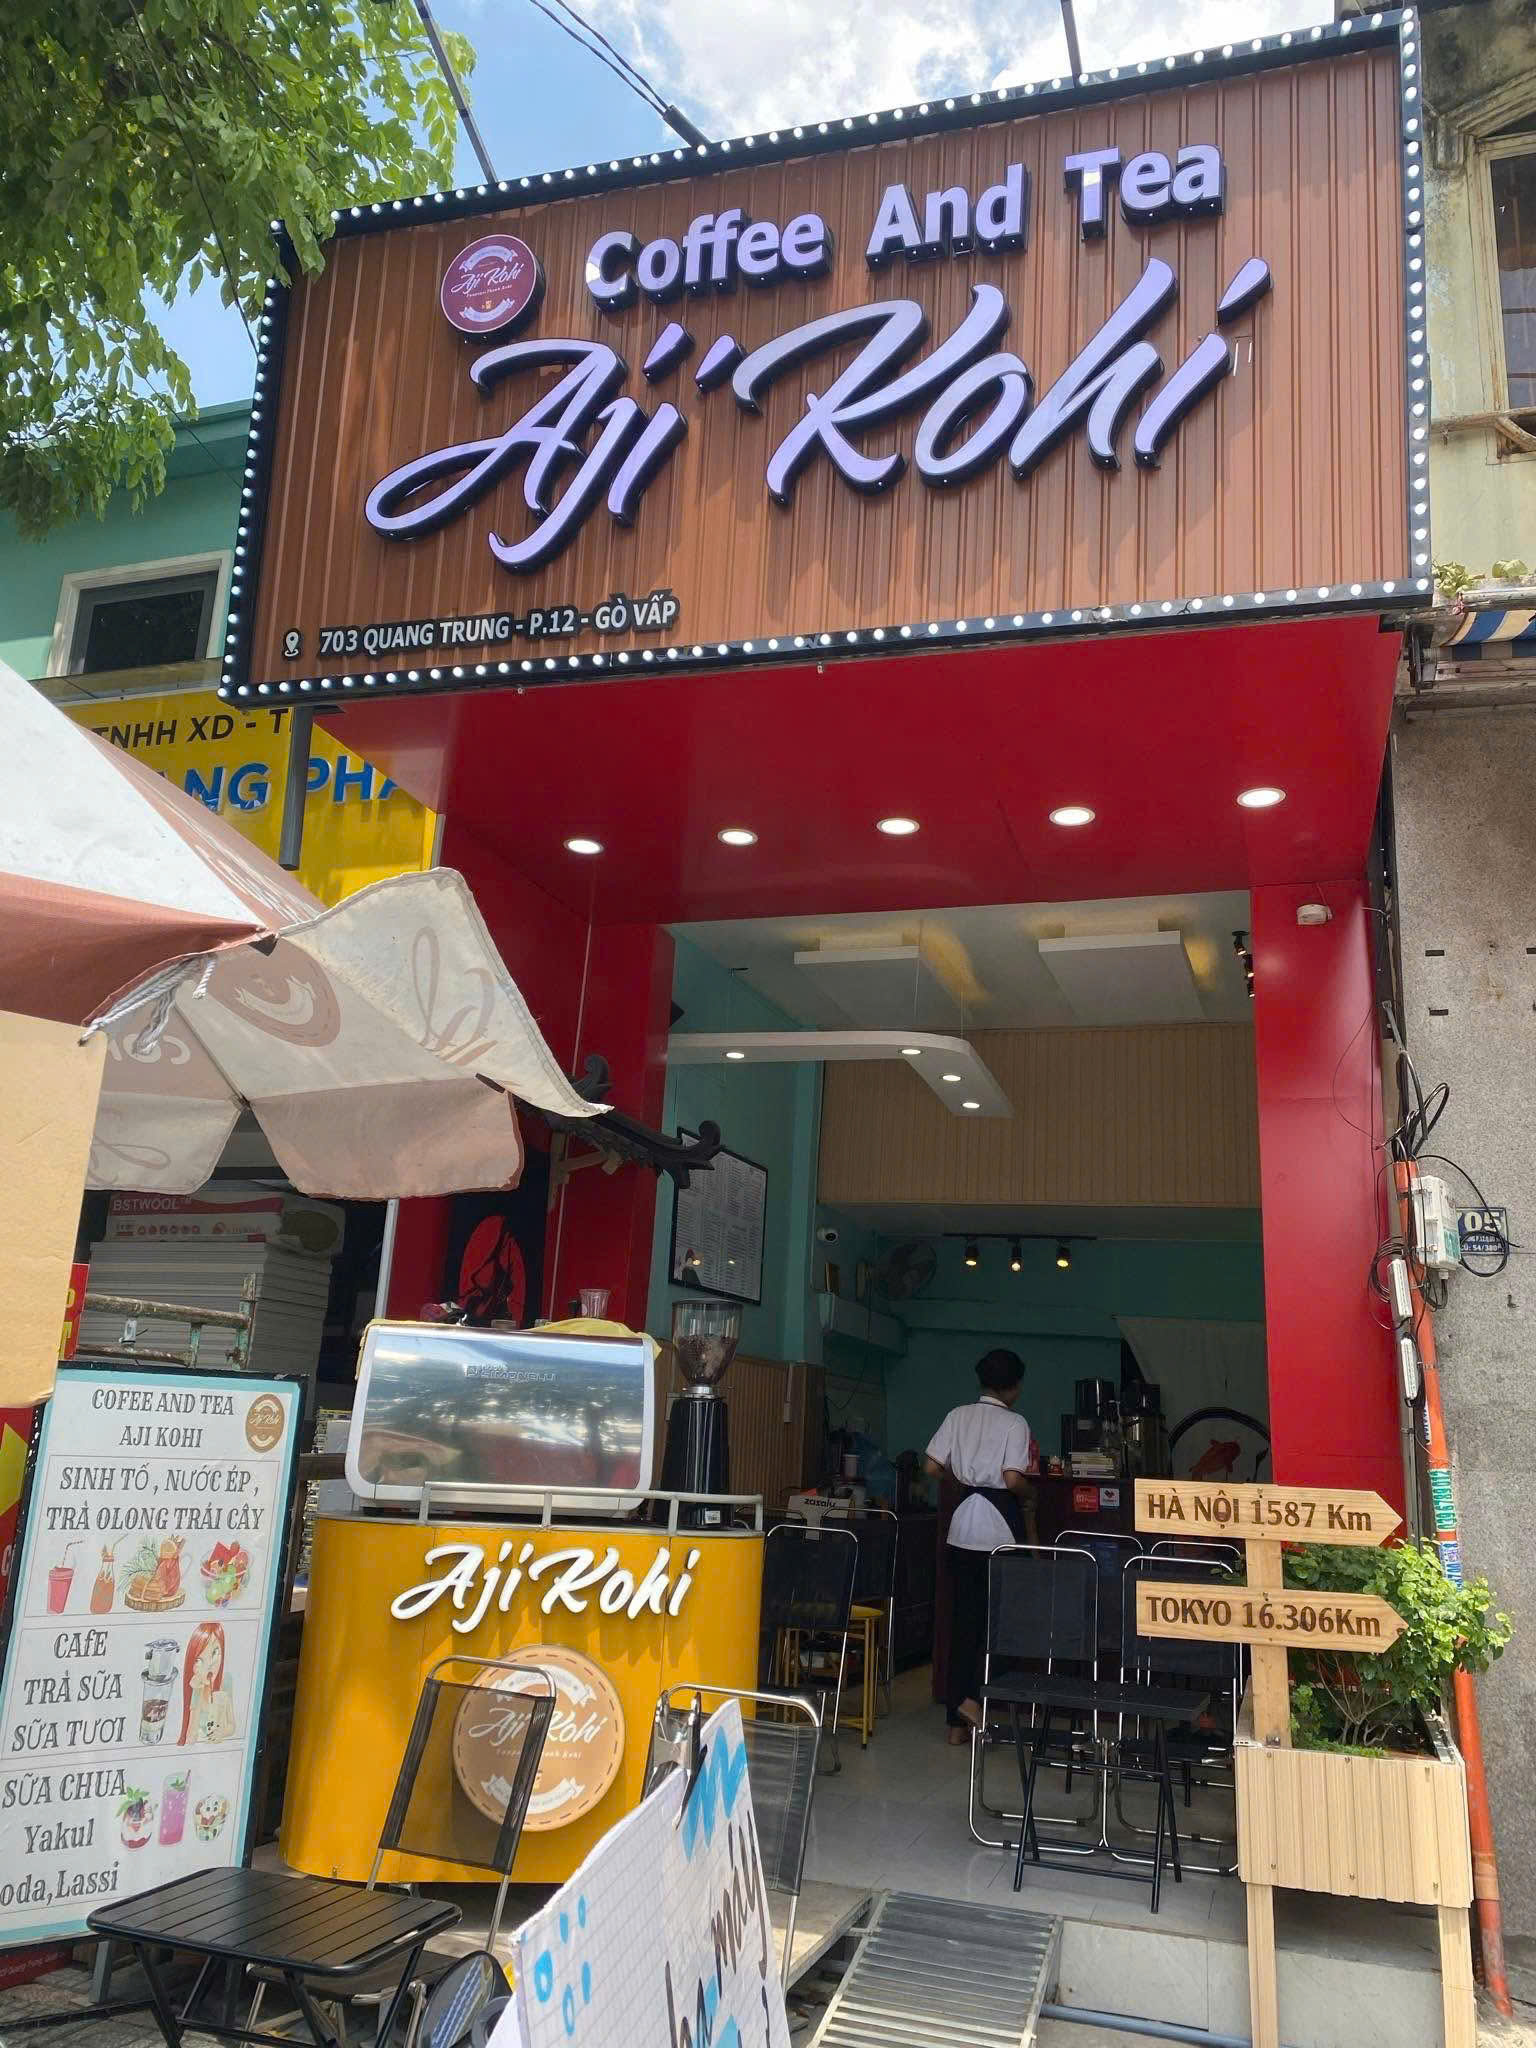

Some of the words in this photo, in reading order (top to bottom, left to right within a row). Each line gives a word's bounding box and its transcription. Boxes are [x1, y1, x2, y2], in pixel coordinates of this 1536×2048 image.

[585, 208, 830, 306] Coffee
[866, 163, 1027, 266] And
[1065, 144, 1223, 237] Tea
[365, 322, 745, 570] Aji
[733, 257, 1271, 503] Kohi
[320, 630, 357, 654] 703
[363, 622, 434, 655] QUANG
[439, 616, 511, 644] TRUNG
[529, 609, 575, 635] P.12
[595, 598, 627, 630] GÒ
[633, 593, 677, 626] VẤP
[188, 714, 234, 742] XD
[1456, 1211, 1502, 1233] 05
[91, 1389, 154, 1411] COFEE
[155, 1392, 196, 1413] AND
[200, 1394, 234, 1415] TEA
[119, 1425, 152, 1446] AJI
[155, 1426, 204, 1448] KOHI
[59, 1466, 116, 1490] SINH
[164, 1465, 222, 1491] NƯỚC
[96, 1506, 169, 1530] OLONG
[173, 1501, 223, 1530] TRÁI
[226, 1502, 264, 1530] CÂY
[1148, 1487, 1185, 1520] HÀ
[1194, 1489, 1240, 1530] NỘI
[1250, 1500, 1316, 1528] 1587
[1328, 1503, 1372, 1531] Km
[390, 1540, 534, 1633] Aji
[528, 1547, 701, 1620] Kohi
[1146, 1596, 1232, 1627] TOKYO
[77, 1670, 122, 1702] SỮA
[11, 1718, 59, 1752] SỮA
[67, 1716, 126, 1746] TƯƠI
[2, 1772, 52, 1808] SỮA
[60, 1768, 127, 1801] CHUA
[24, 1818, 95, 1855] Yakul
